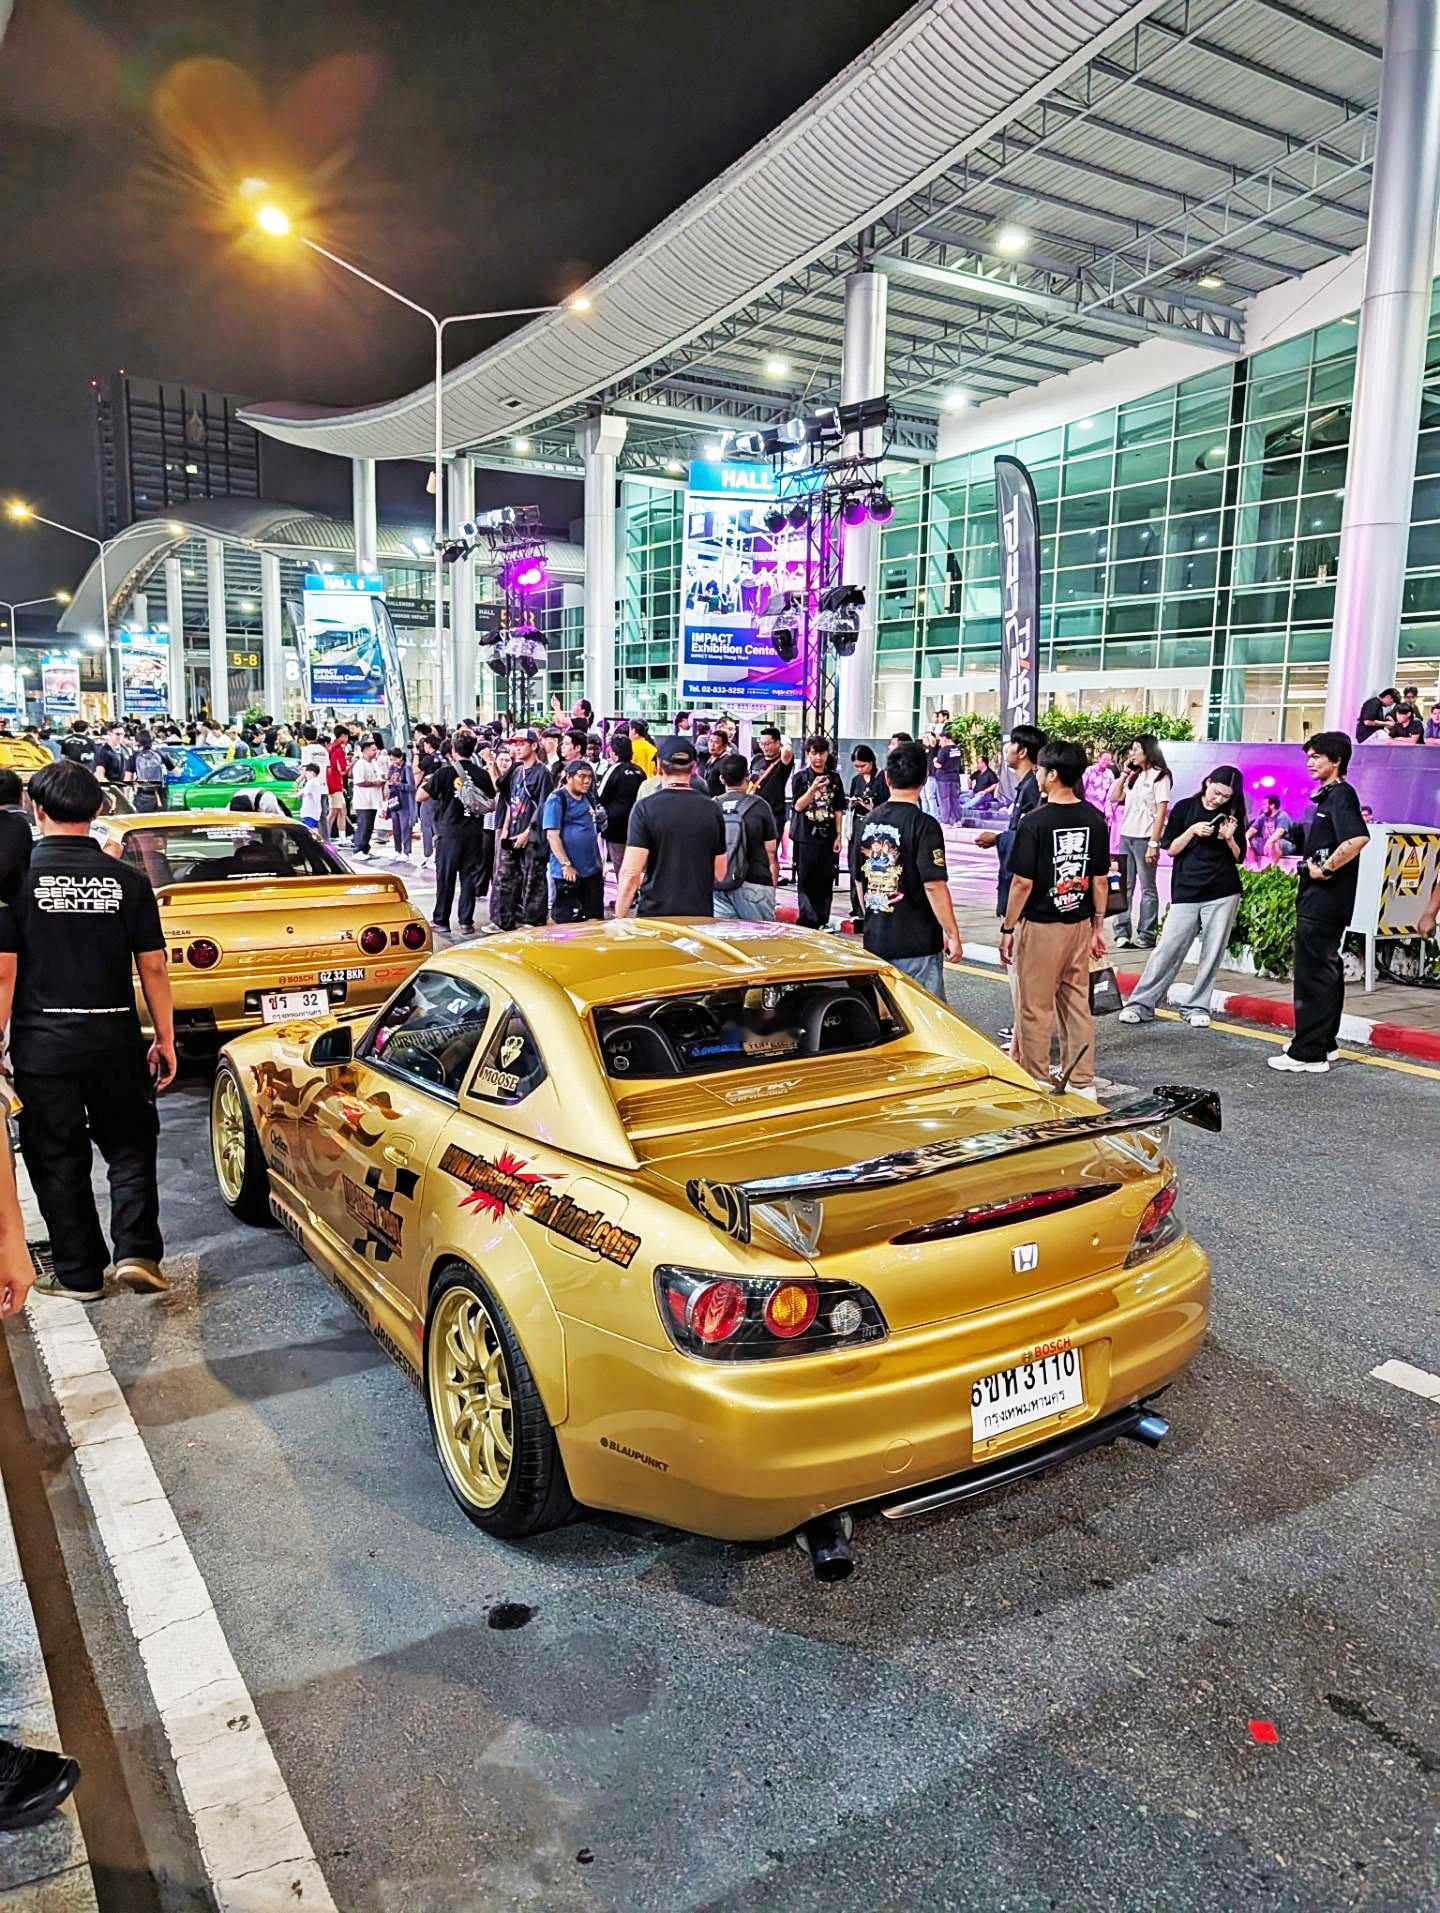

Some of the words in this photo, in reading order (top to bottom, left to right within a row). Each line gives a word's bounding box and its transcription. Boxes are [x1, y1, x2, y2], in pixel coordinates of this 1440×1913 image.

[722, 470, 775, 490] HALL
[691, 632, 734, 644] IMPACT
[691, 642, 743, 655] Exhibition
[744, 644, 779, 656] Cente
[232, 653, 258, 666] 5-8
[285, 660, 300, 681] 8
[1058, 831, 1085, 855] 東
[38, 875, 117, 888] SQUAD
[33, 887, 123, 900] SERVICE
[37, 898, 120, 911] CENTER
[287, 975, 314, 983] BOSCH
[320, 971, 333, 982] GZ
[333, 970, 345, 981] 32
[346, 968, 364, 979] BKK
[302, 993, 319, 1007] 32
[479, 1067, 520, 1092] MOOSE
[1034, 1337, 1072, 1358] BOSCH
[1023, 1350, 1075, 1391] 3110
[983, 1390, 1066, 1428] กรุงเทพมหานคร
[608, 1440, 670, 1472] BLAUPUNKT
